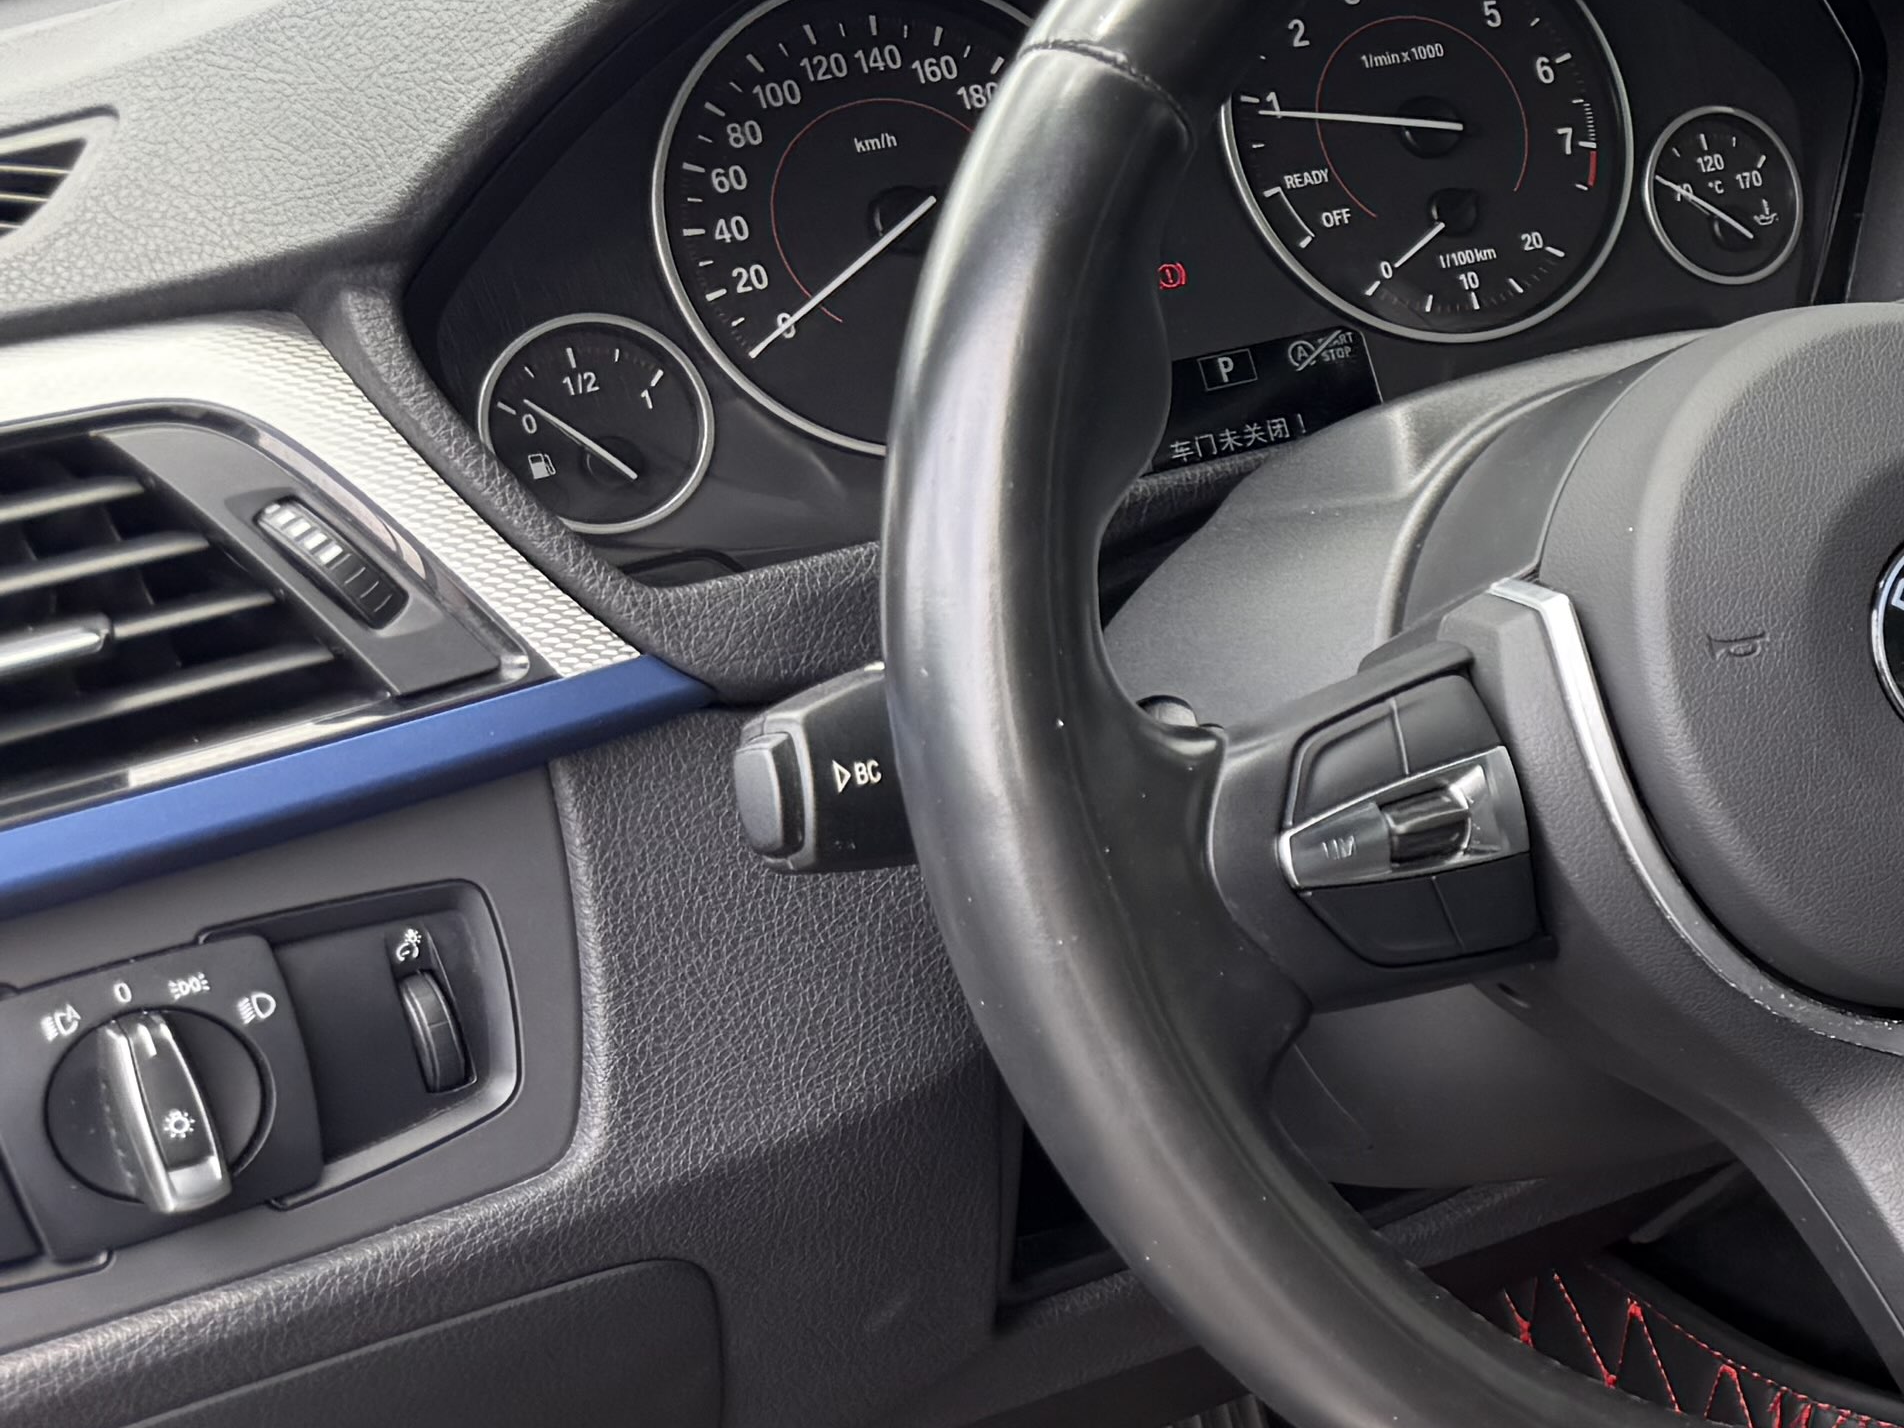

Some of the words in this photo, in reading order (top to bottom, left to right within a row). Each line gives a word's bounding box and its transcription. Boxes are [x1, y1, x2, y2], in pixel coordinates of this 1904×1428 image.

[1482, 0, 1502, 29] 5
[1287, 18, 1310, 48] 2
[800, 51, 848, 82] 120
[854, 43, 902, 71] 140
[1361, 52, 1400, 69] 1/min
[1411, 43, 1444, 60] 1000
[911, 54, 959, 85] 160
[1535, 57, 1556, 86] 6
[752, 78, 802, 111] 100
[726, 119, 764, 150] 80
[854, 131, 898, 155] km/h
[1557, 127, 1575, 155] 7
[1696, 154, 1725, 173] 120
[711, 164, 748, 194] 60
[1284, 169, 1331, 190] READY
[1708, 180, 1724, 194] °C
[1735, 170, 1763, 189] 170
[714, 215, 749, 243] 40
[1321, 208, 1352, 228] OFF
[1520, 232, 1544, 254] 20
[732, 264, 769, 294] 20
[1379, 260, 1393, 280] 0
[1459, 271, 1480, 291] 10
[1321, 346, 1352, 362] STOP
[1217, 356, 1234, 383] P
[562, 371, 600, 396] 1/2
[640, 388, 653, 410] 1
[522, 413, 538, 434] 0
[854, 759, 882, 785] BC
